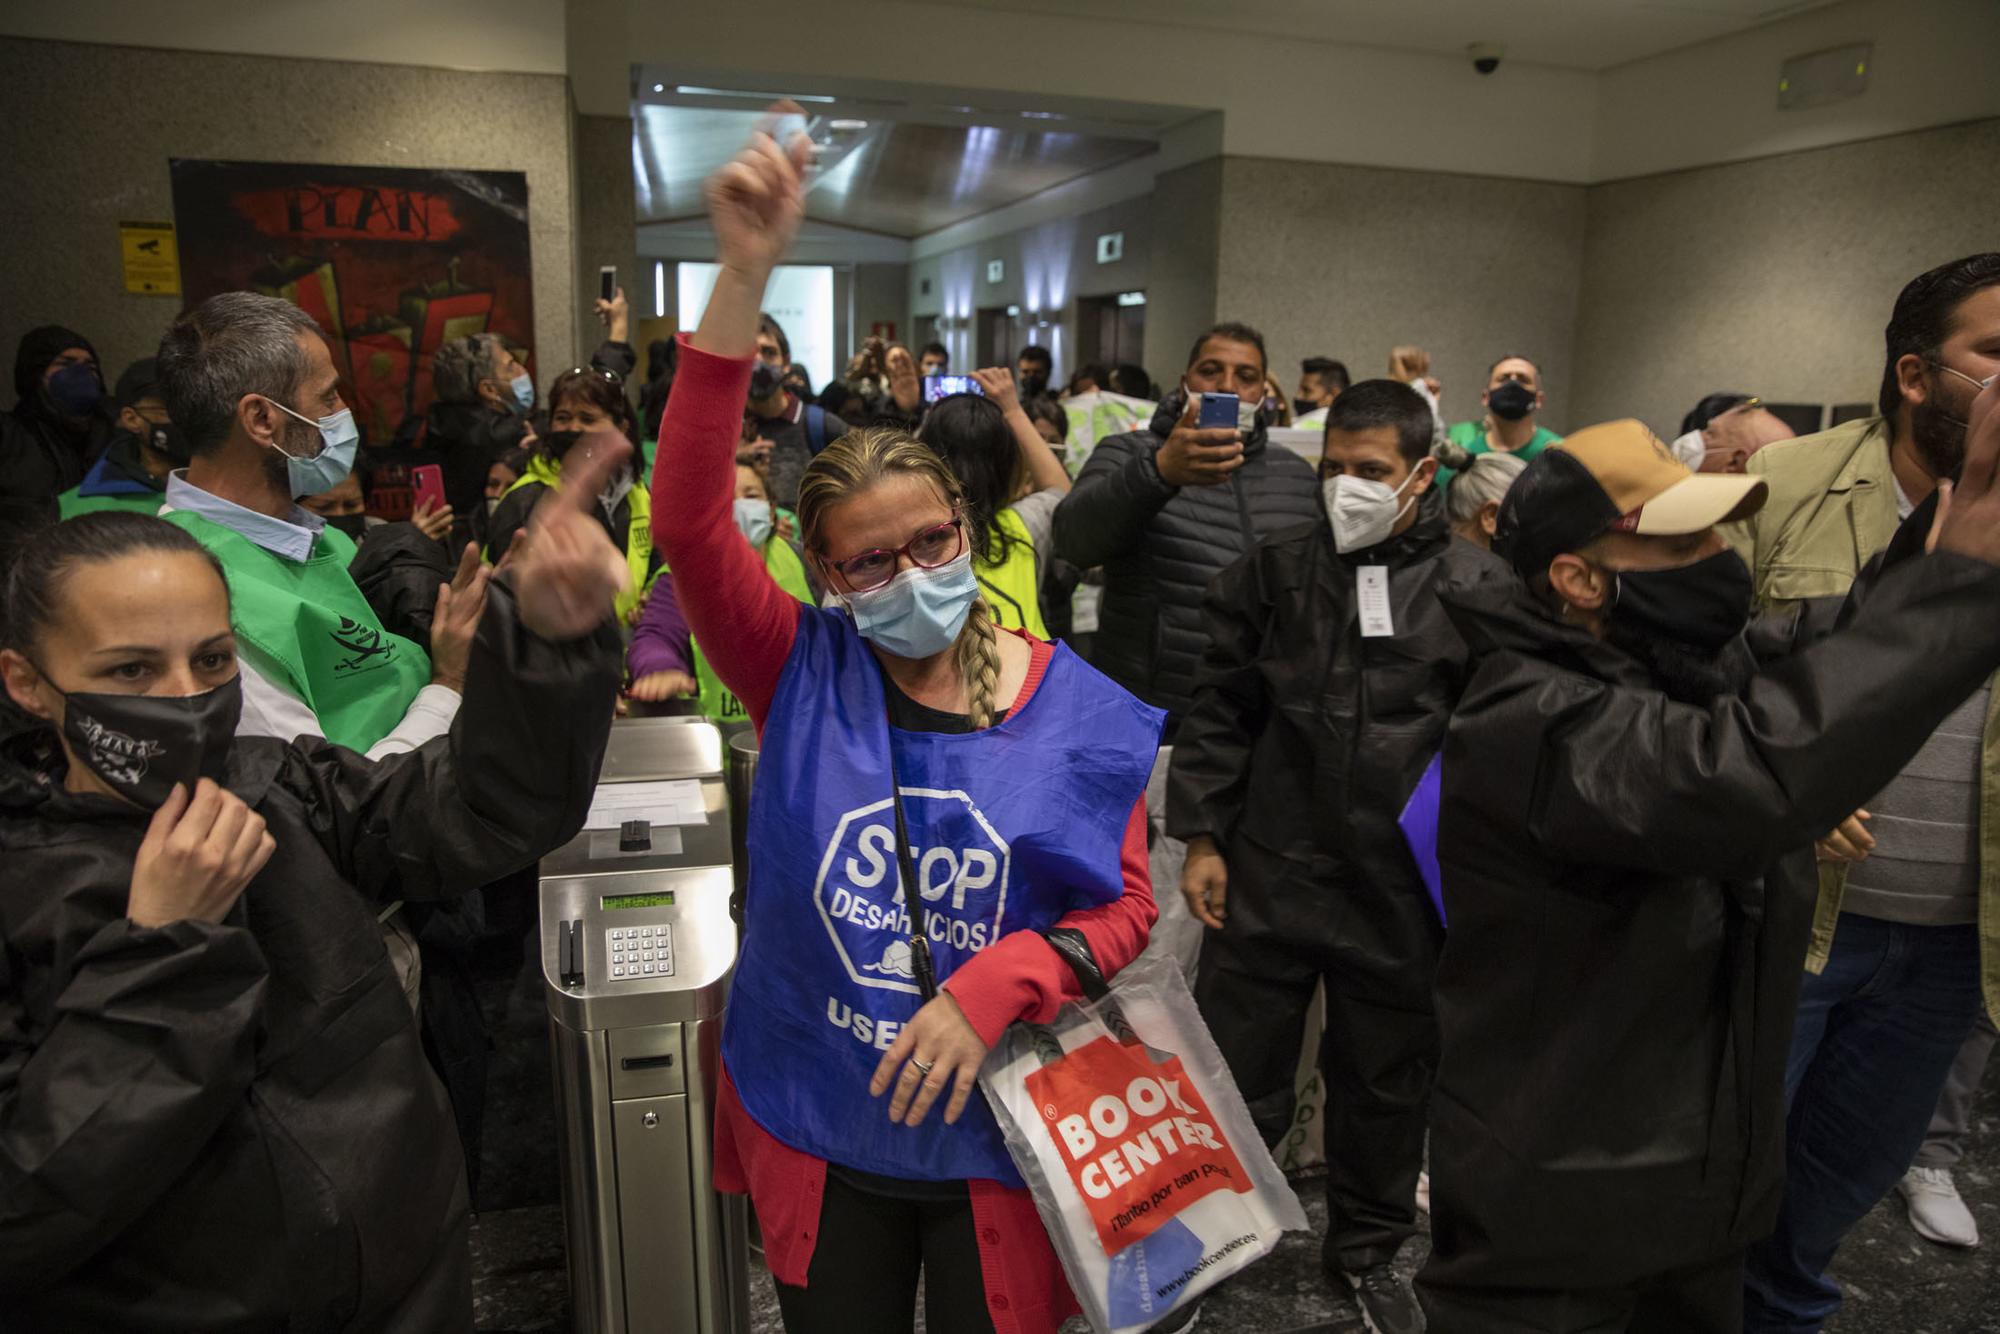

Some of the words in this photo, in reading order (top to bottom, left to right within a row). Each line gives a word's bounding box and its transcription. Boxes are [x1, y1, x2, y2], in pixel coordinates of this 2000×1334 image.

[284, 186, 431, 239] PLAN
[721, 692, 746, 716] LA
[827, 996, 909, 1052] USE
[1055, 1076, 1200, 1161] BOOK
[1080, 1116, 1225, 1200] CENTER
[1151, 1183, 1173, 1208] por
[1174, 1168, 1201, 1190] tan
